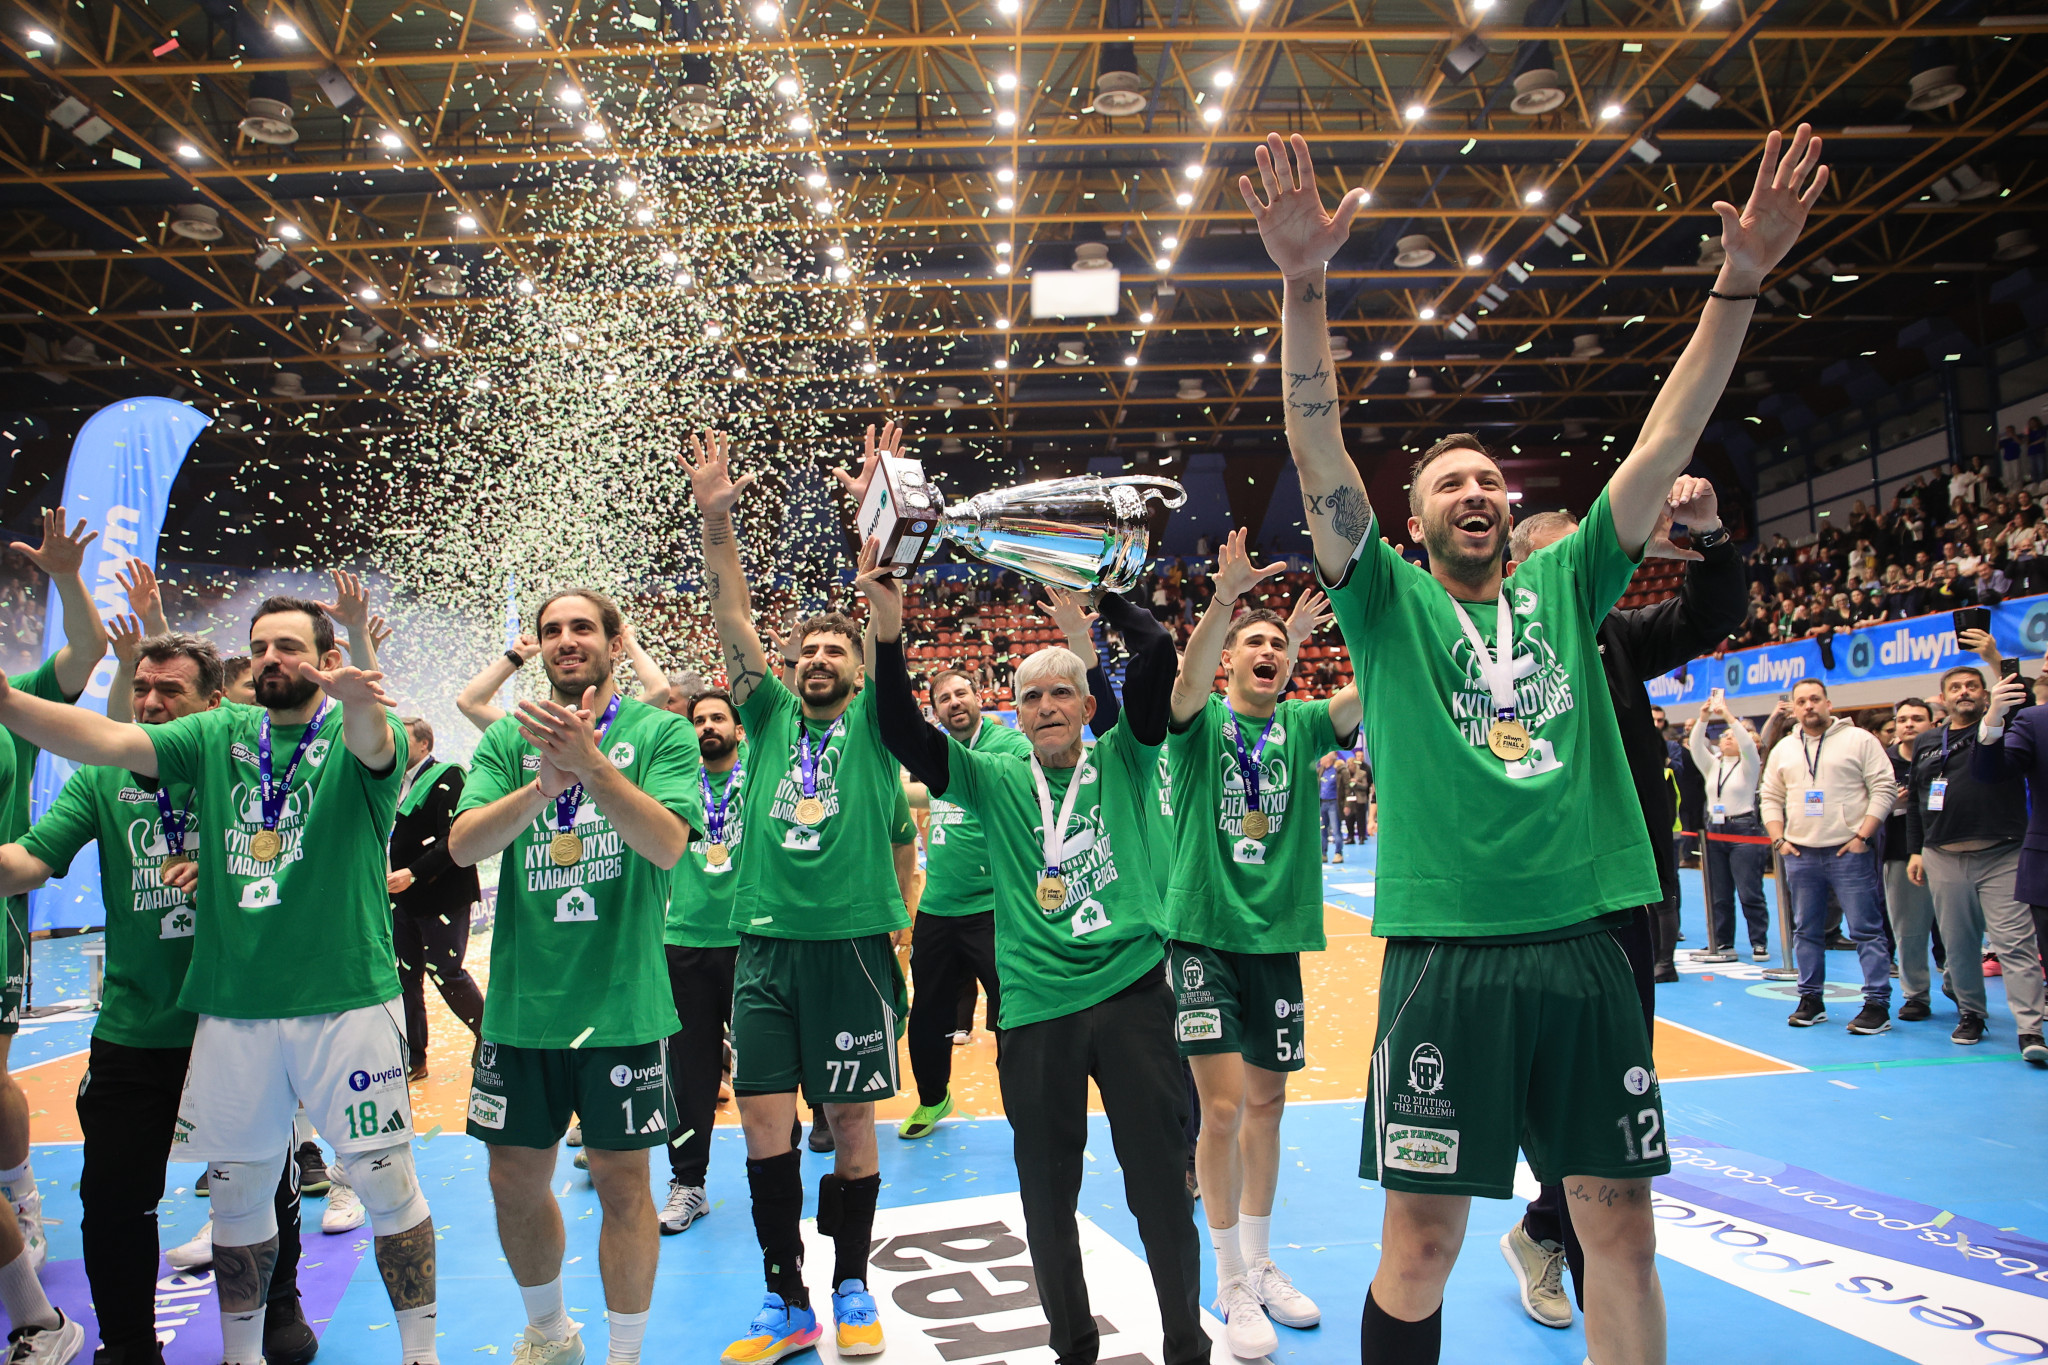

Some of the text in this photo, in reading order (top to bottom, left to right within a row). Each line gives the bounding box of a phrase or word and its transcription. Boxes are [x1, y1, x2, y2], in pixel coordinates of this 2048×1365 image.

[1879, 628, 1960, 668] allwyn
[1747, 653, 1805, 689] allwyn
[528, 857, 622, 891] ΕΛΛΑΔΟΣ 2026
[1276, 1027, 1291, 1062] 5
[826, 1060, 861, 1093] 77
[621, 1097, 636, 1135] 1
[1393, 1101, 1412, 1113] ΤΗΣ
[1413, 1105, 1456, 1117] ΓΙΑΣΕΜΗ
[1398, 1093, 1451, 1109] ΤΟ ΣΠΙΤΙΚΟ
[345, 1100, 379, 1139] 18
[1616, 1107, 1664, 1160] 12
[1388, 1129, 1457, 1149] ART FANTASY
